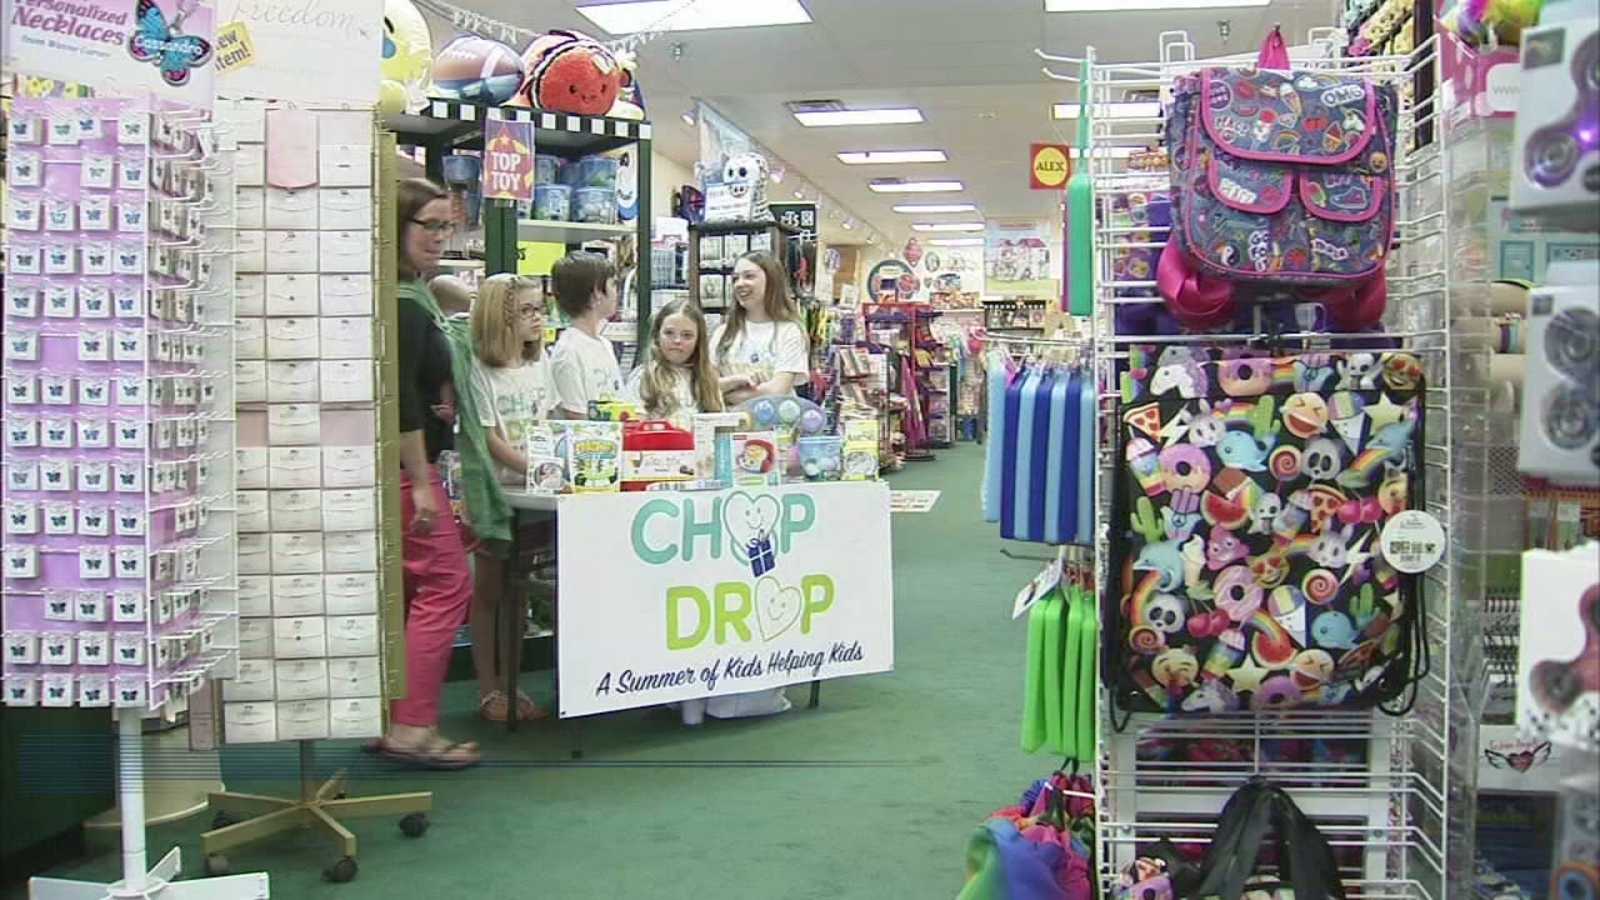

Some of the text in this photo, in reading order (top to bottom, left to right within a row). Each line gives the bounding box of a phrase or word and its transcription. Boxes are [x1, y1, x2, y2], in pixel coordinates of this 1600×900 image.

[12, 6, 126, 45] Necklaces
[214, 29, 238, 50] ew
[1323, 85, 1363, 105] OMG
[490, 152, 521, 171] TOP
[1036, 161, 1065, 171] ALEX
[490, 171, 521, 190] TOY
[631, 490, 815, 566] CHOP
[666, 574, 835, 650] DROP
[595, 640, 864, 696] A Summer of Kids Helping Kids
